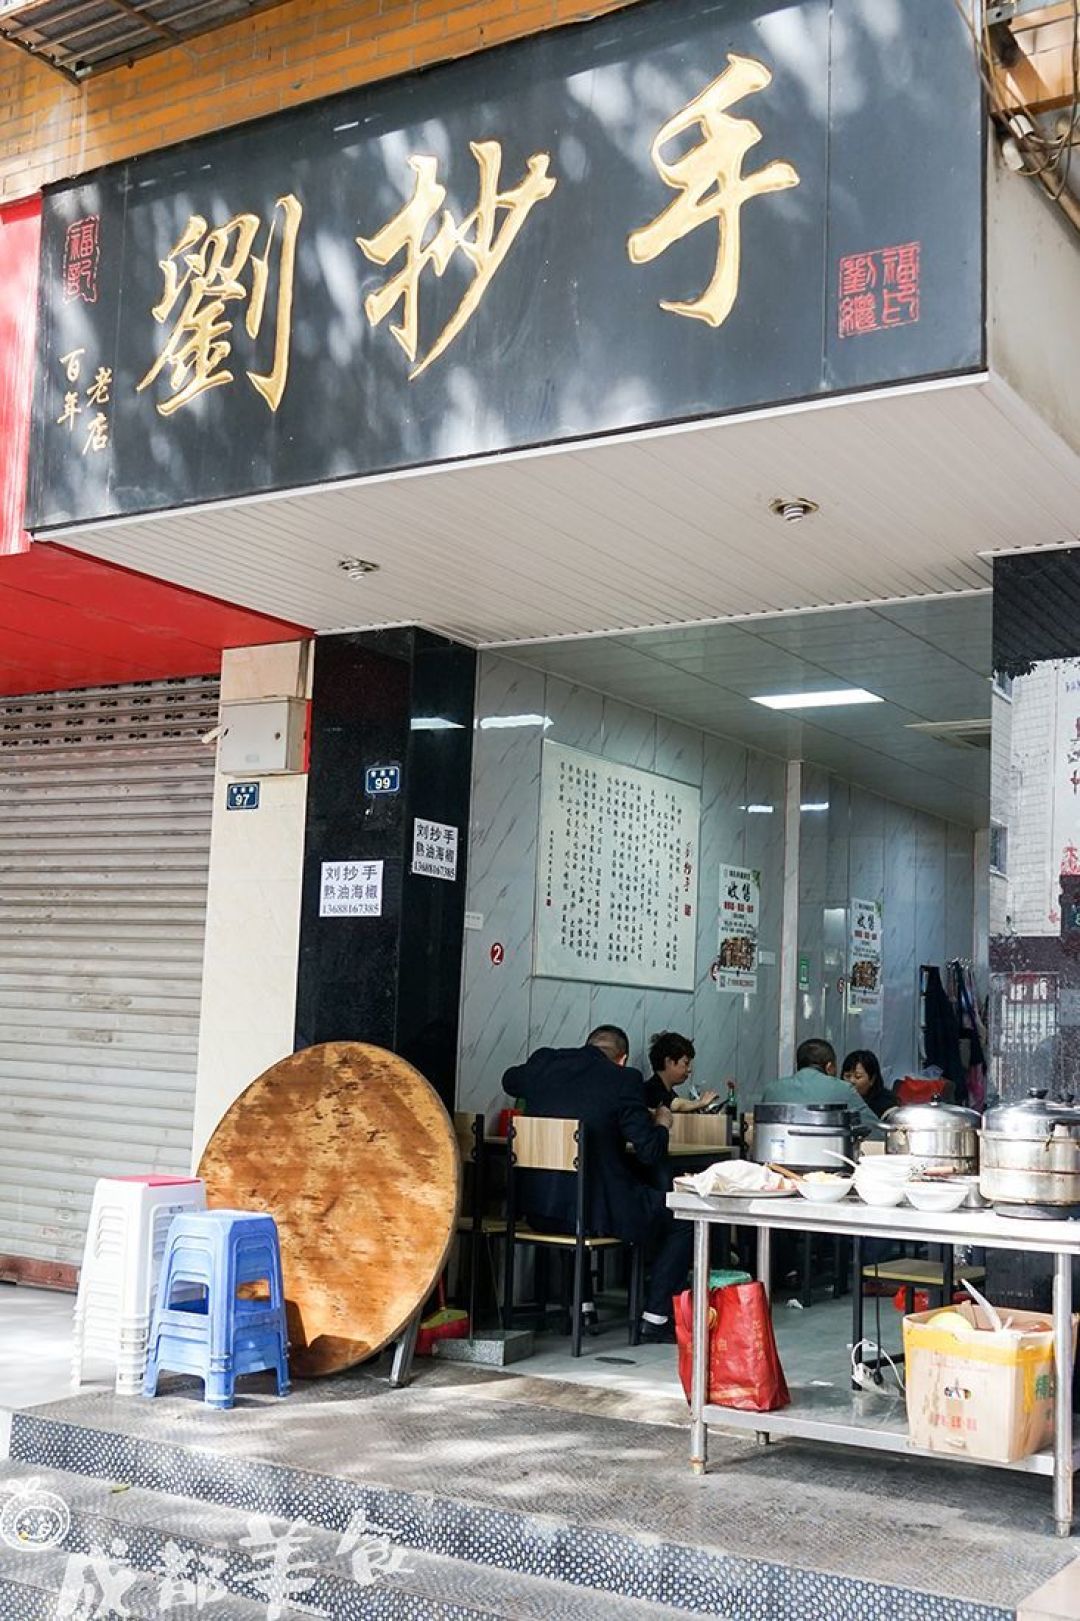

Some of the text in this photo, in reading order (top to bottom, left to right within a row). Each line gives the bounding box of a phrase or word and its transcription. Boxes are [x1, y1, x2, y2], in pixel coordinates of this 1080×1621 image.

[57, 348, 86, 431] 百年
[82, 367, 113, 456] 老店
[375, 777, 391, 790] 99
[235, 793, 250, 807] 97
[416, 823, 455, 845] 刘抄手
[325, 864, 378, 882] 刘抄手
